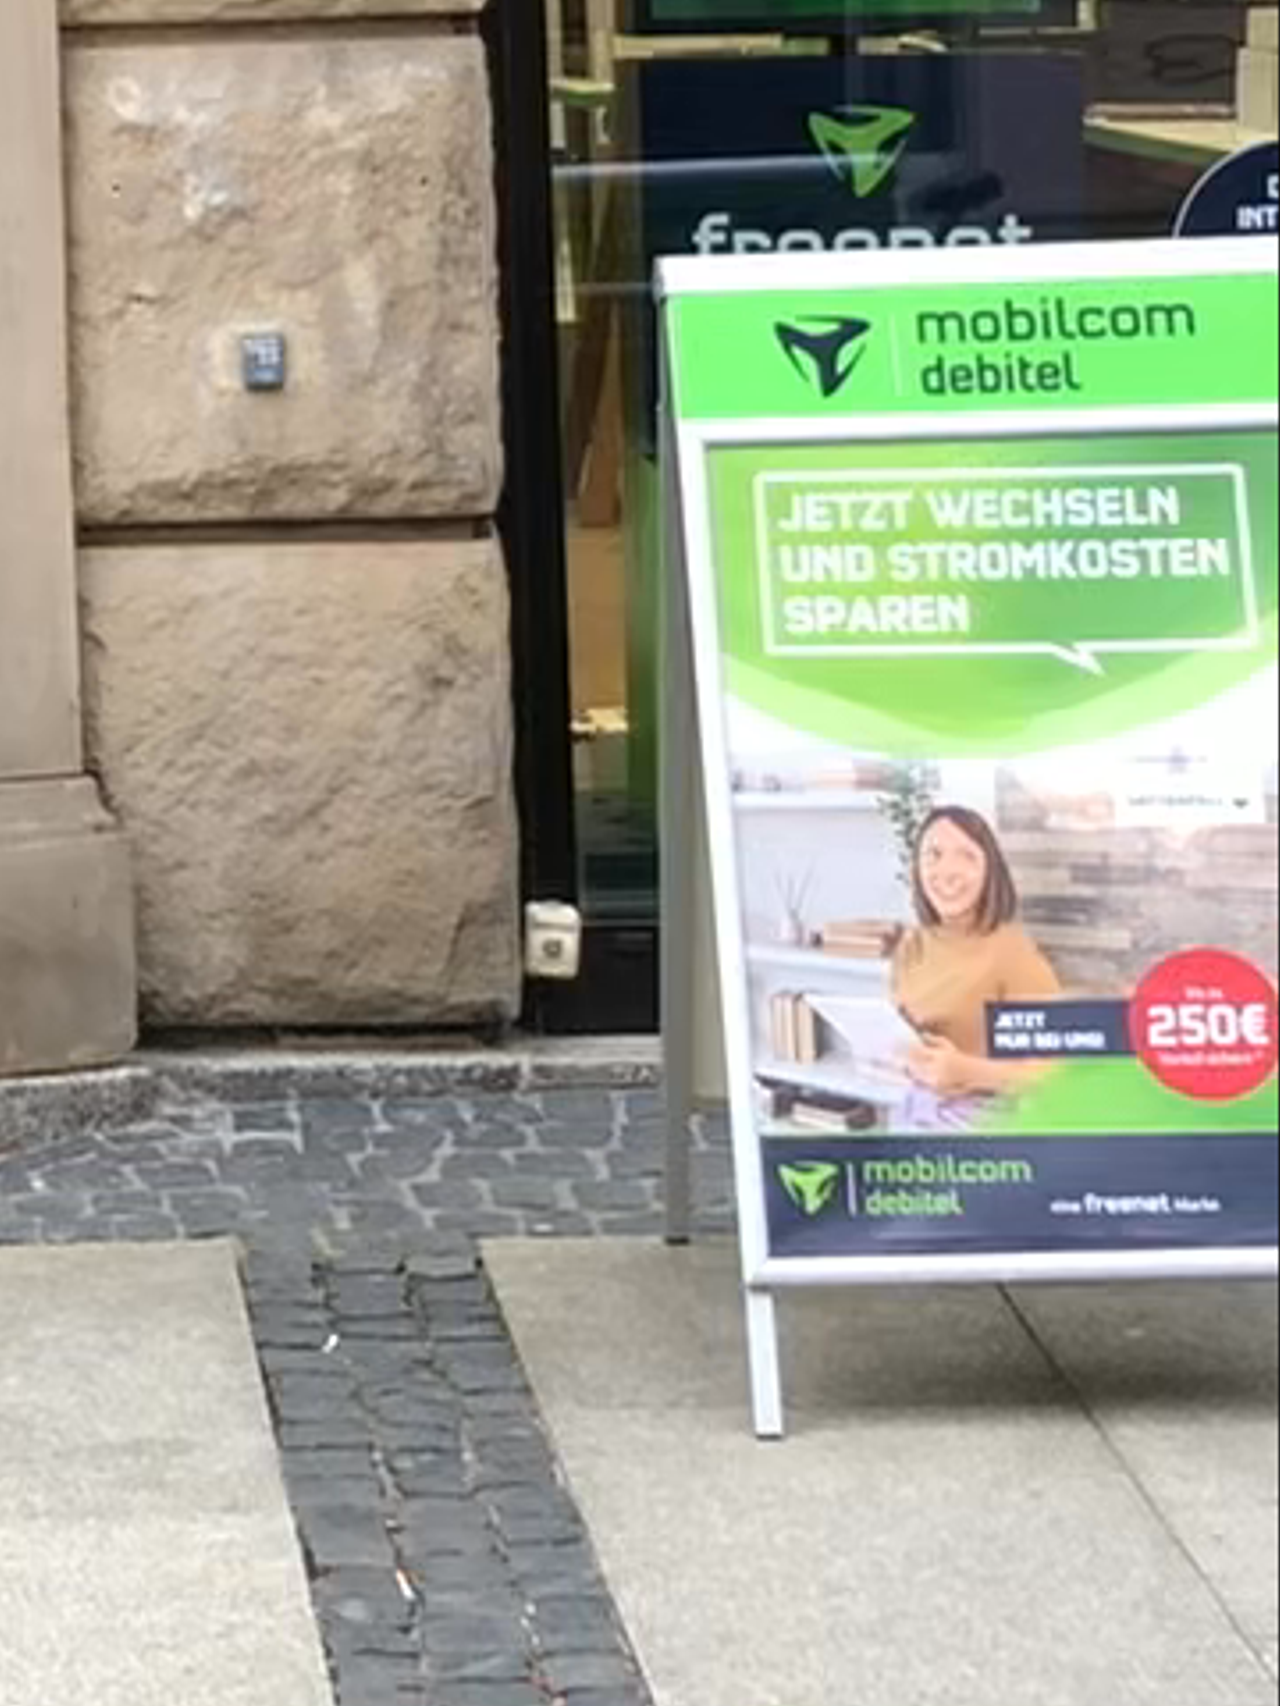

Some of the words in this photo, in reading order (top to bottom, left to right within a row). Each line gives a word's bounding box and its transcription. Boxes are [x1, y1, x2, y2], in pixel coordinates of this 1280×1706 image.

[915, 295, 1197, 344] mobilcom
[920, 350, 1084, 397] debitel
[778, 490, 912, 533] JETZT
[925, 485, 1181, 528] WECHSELN
[779, 543, 876, 584] UND
[889, 536, 1231, 582] STROMKOSTEN
[783, 592, 971, 635] SPAREN
[1147, 1002, 1270, 1047] 250€
[863, 1156, 1033, 1186] mobilcom
[865, 1189, 963, 1217] debitel
[1083, 1192, 1173, 1215] freenet
